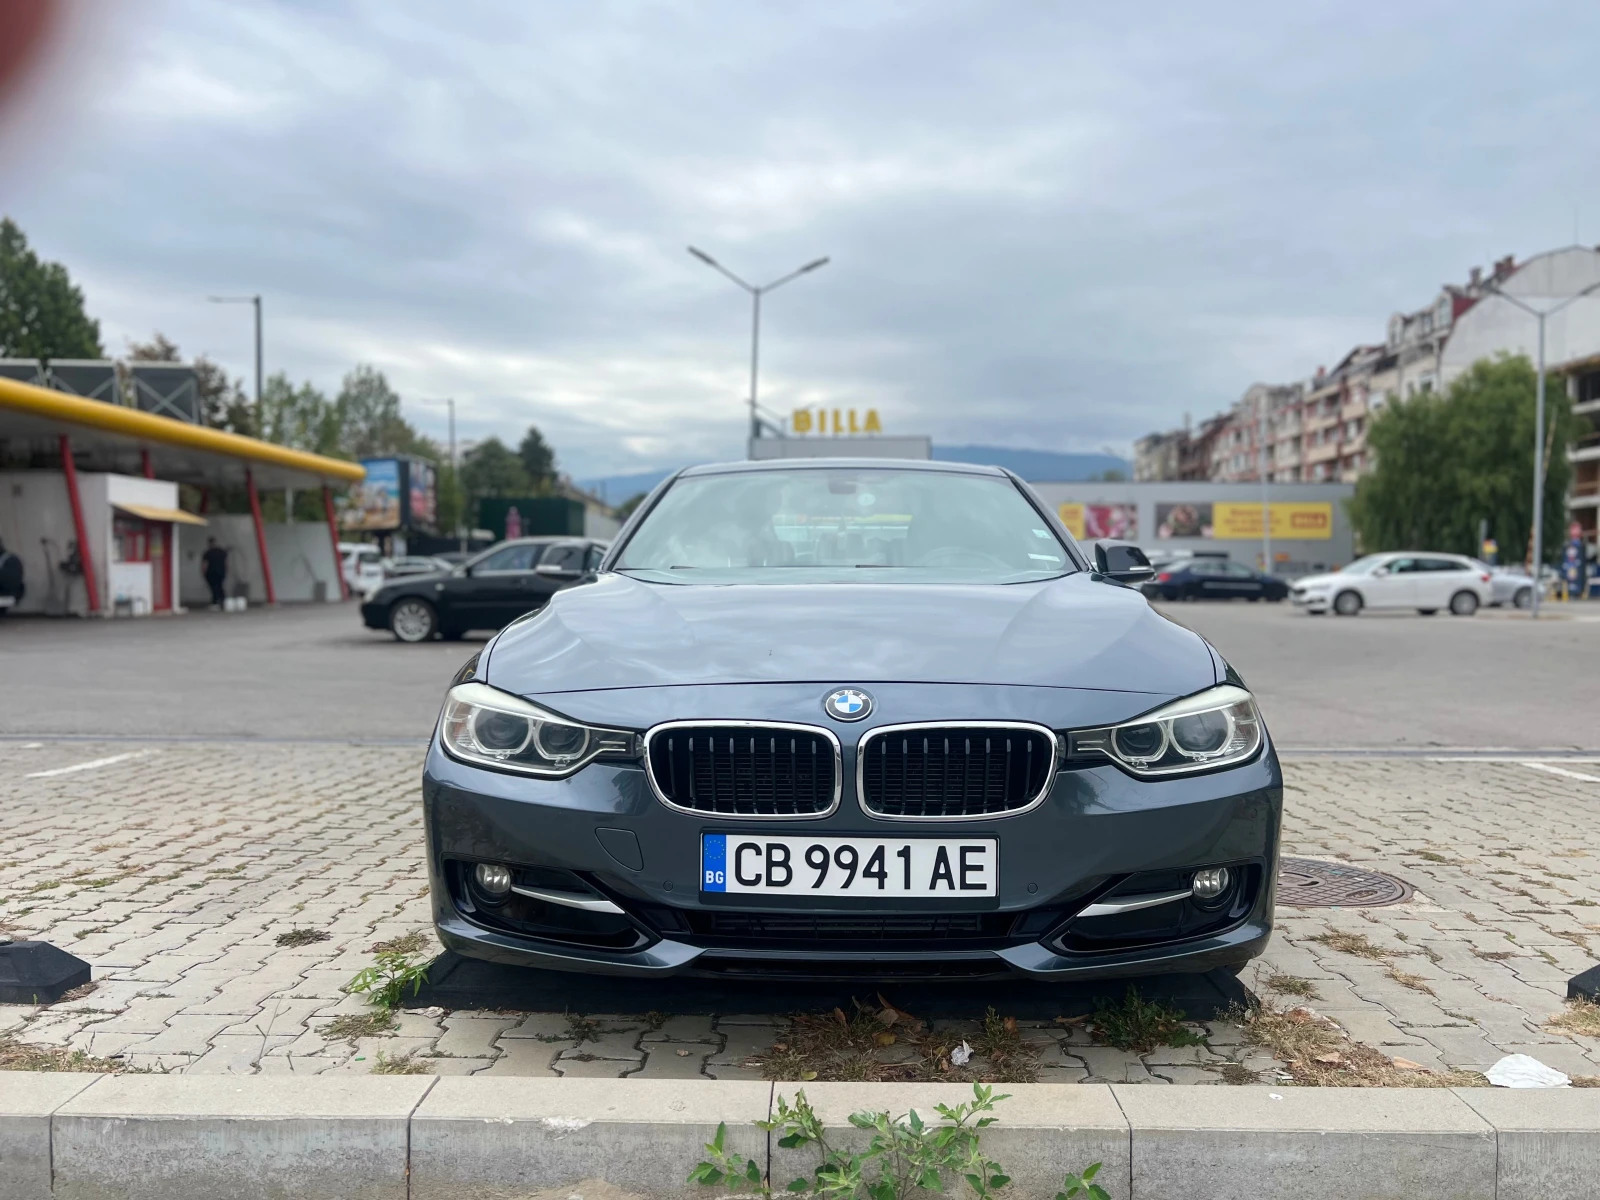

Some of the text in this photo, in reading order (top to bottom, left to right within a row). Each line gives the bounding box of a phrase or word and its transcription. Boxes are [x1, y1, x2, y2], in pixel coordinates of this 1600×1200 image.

[793, 409, 881, 432] BILLA
[830, 689, 868, 700] BMW
[734, 842, 987, 890] CB 9941 AE
[705, 870, 724, 884] BG
